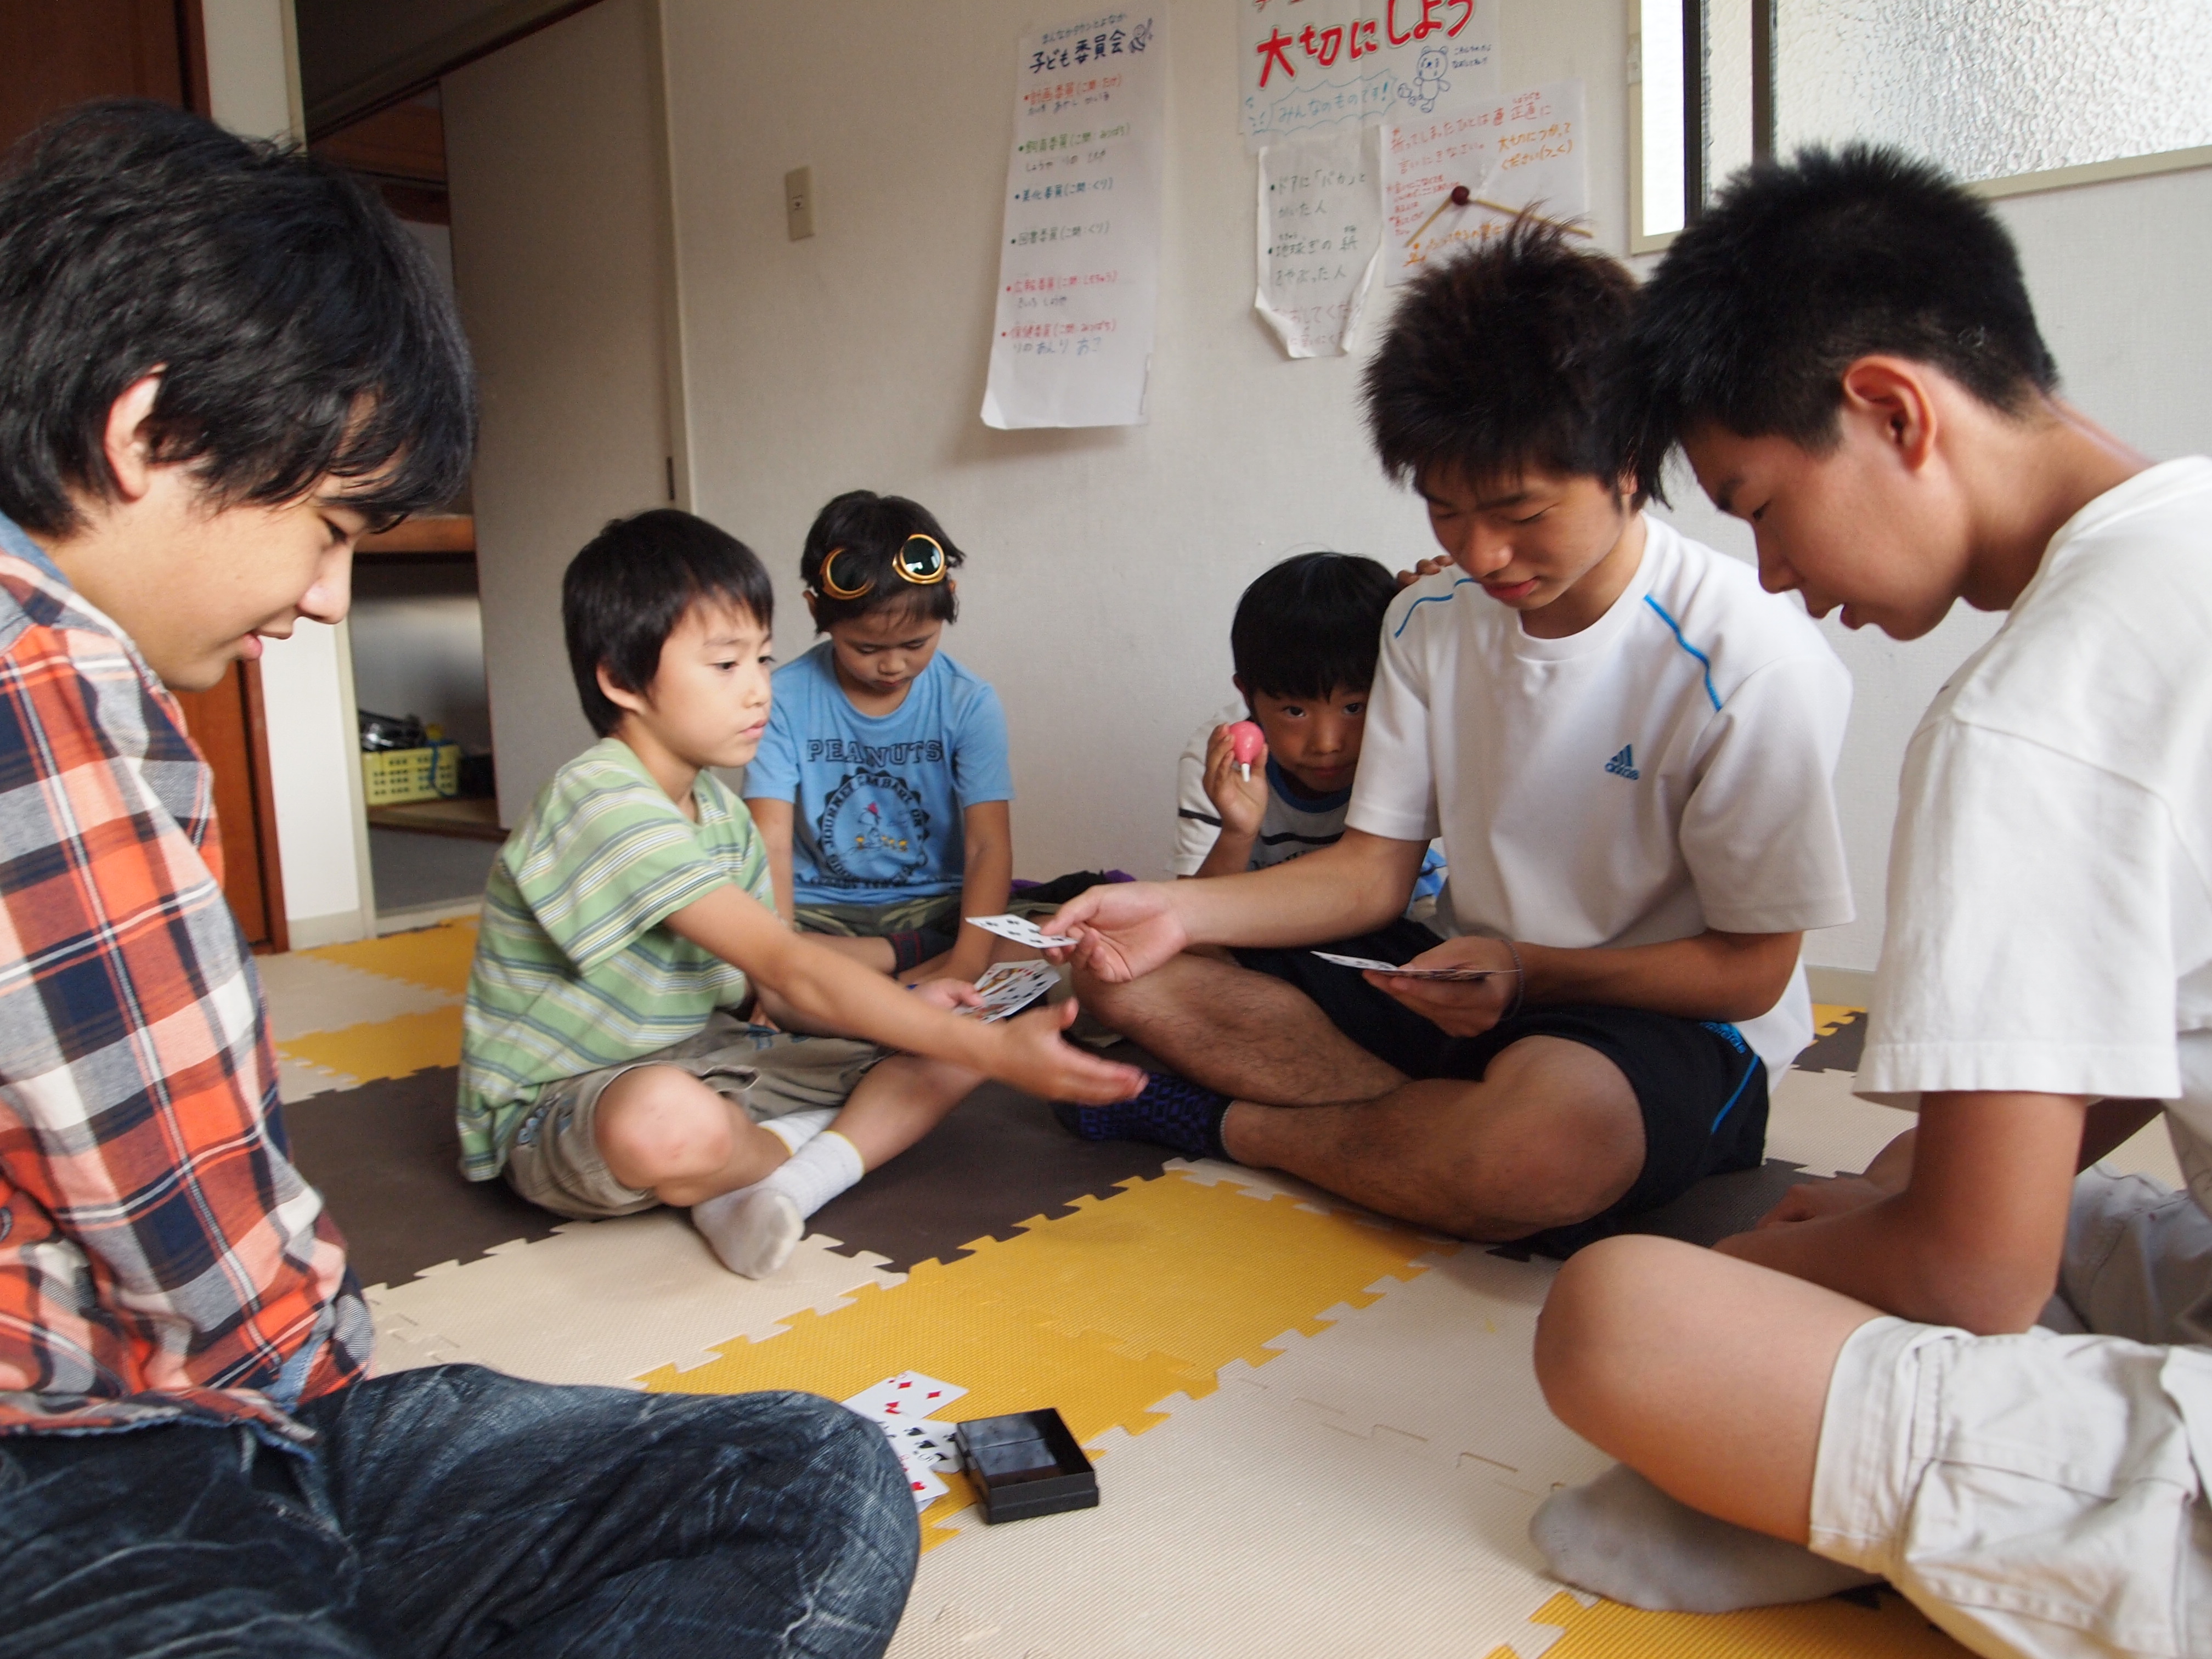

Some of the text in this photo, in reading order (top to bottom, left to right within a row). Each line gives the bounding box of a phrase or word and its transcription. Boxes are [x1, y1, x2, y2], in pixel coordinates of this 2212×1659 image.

[1029, 29, 1126, 74] 子ども委員会
[1257, 0, 1474, 88] 大切にしよう
[806, 740, 944, 768] PEANUTS
